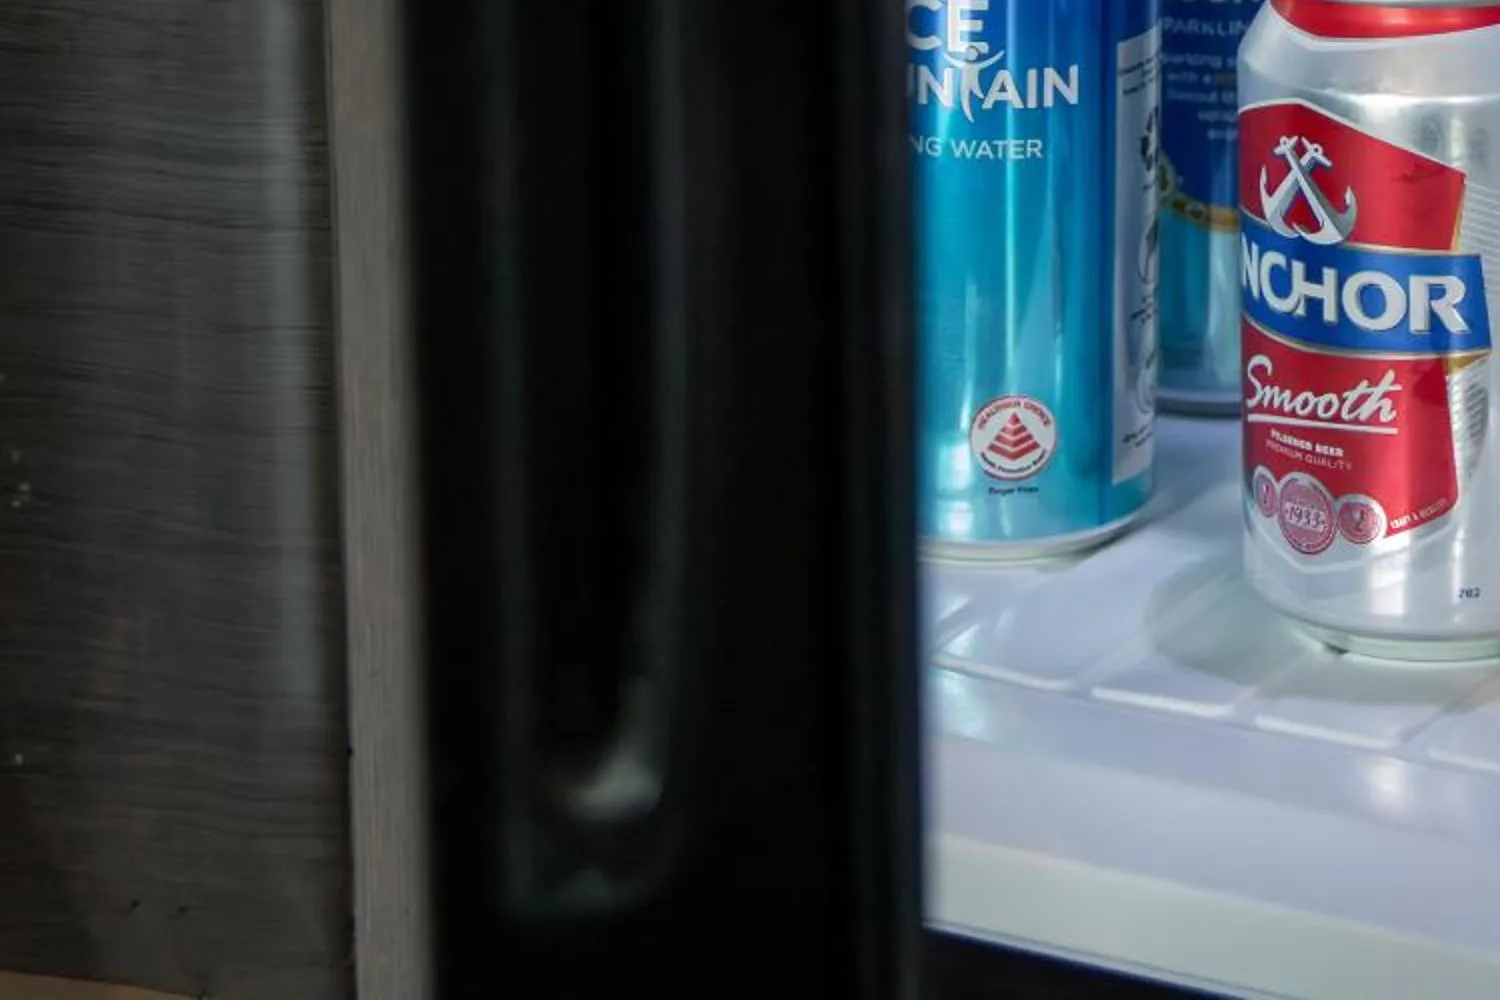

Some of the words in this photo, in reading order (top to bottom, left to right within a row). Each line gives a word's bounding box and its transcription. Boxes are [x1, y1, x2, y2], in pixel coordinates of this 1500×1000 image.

[907, 50, 1080, 123] NTAIN
[952, 138, 1043, 160] WATER
[1240, 231, 1473, 335] NCHOR
[1247, 355, 1402, 423] Smooth
